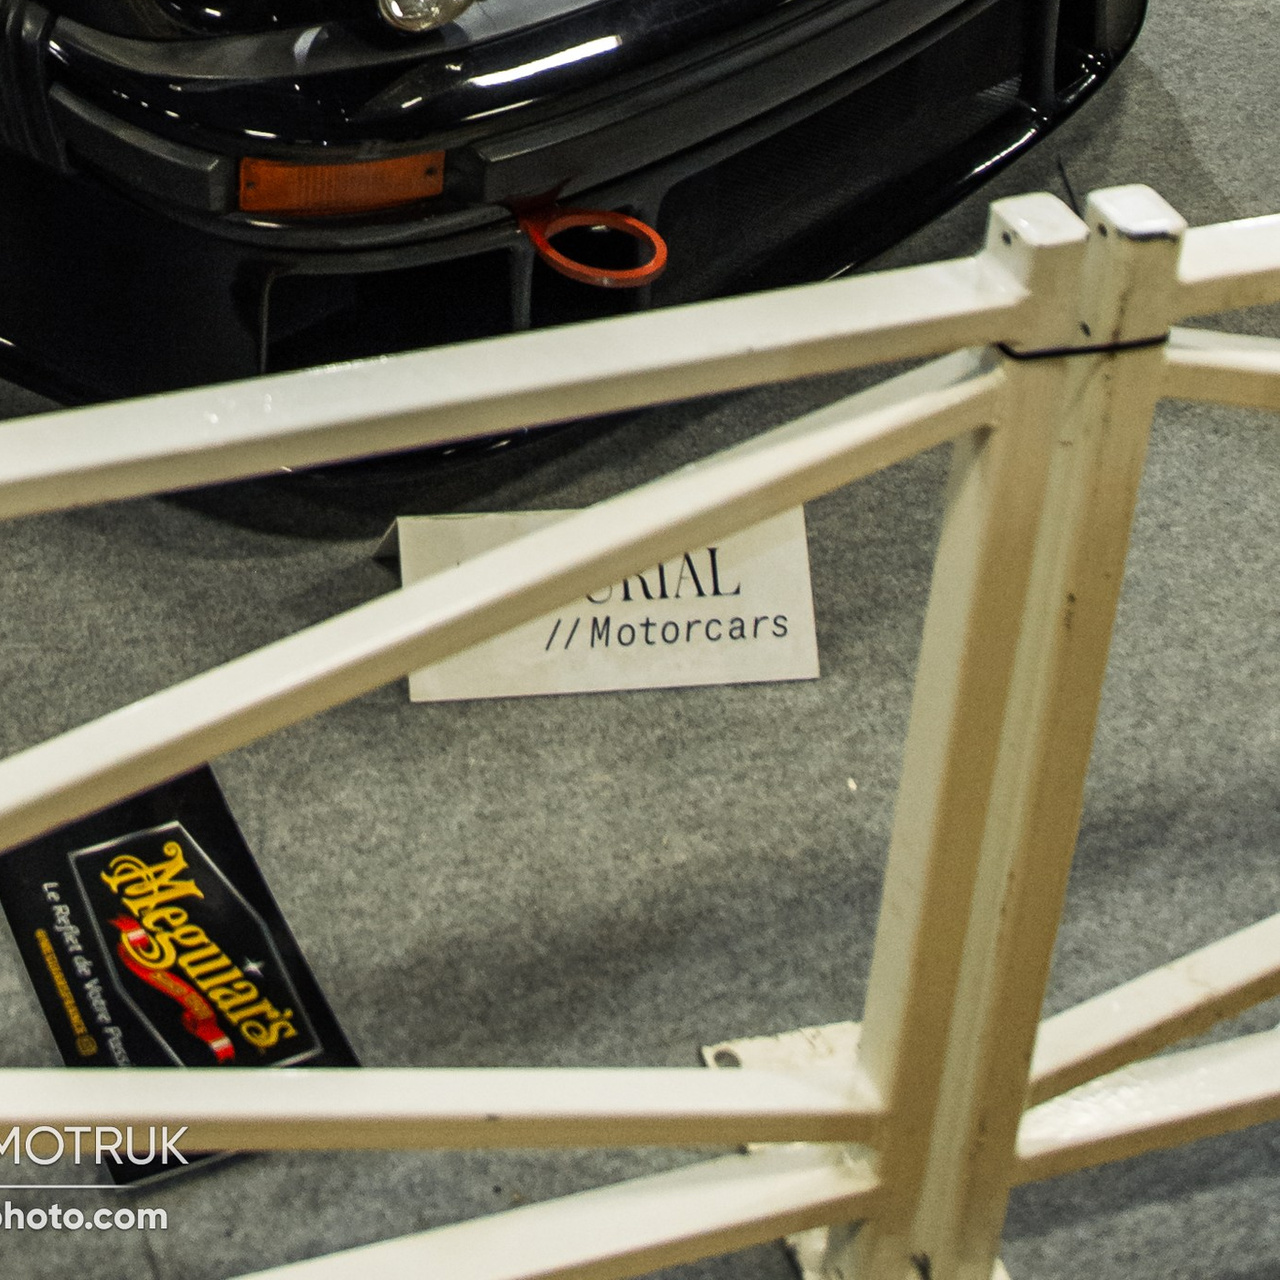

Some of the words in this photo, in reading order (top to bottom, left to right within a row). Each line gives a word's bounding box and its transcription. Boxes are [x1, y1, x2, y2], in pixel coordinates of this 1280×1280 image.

[545, 614, 789, 651] //Motorcars
[42, 881, 61, 903] Le
[101, 841, 298, 1048] Meguiar's
